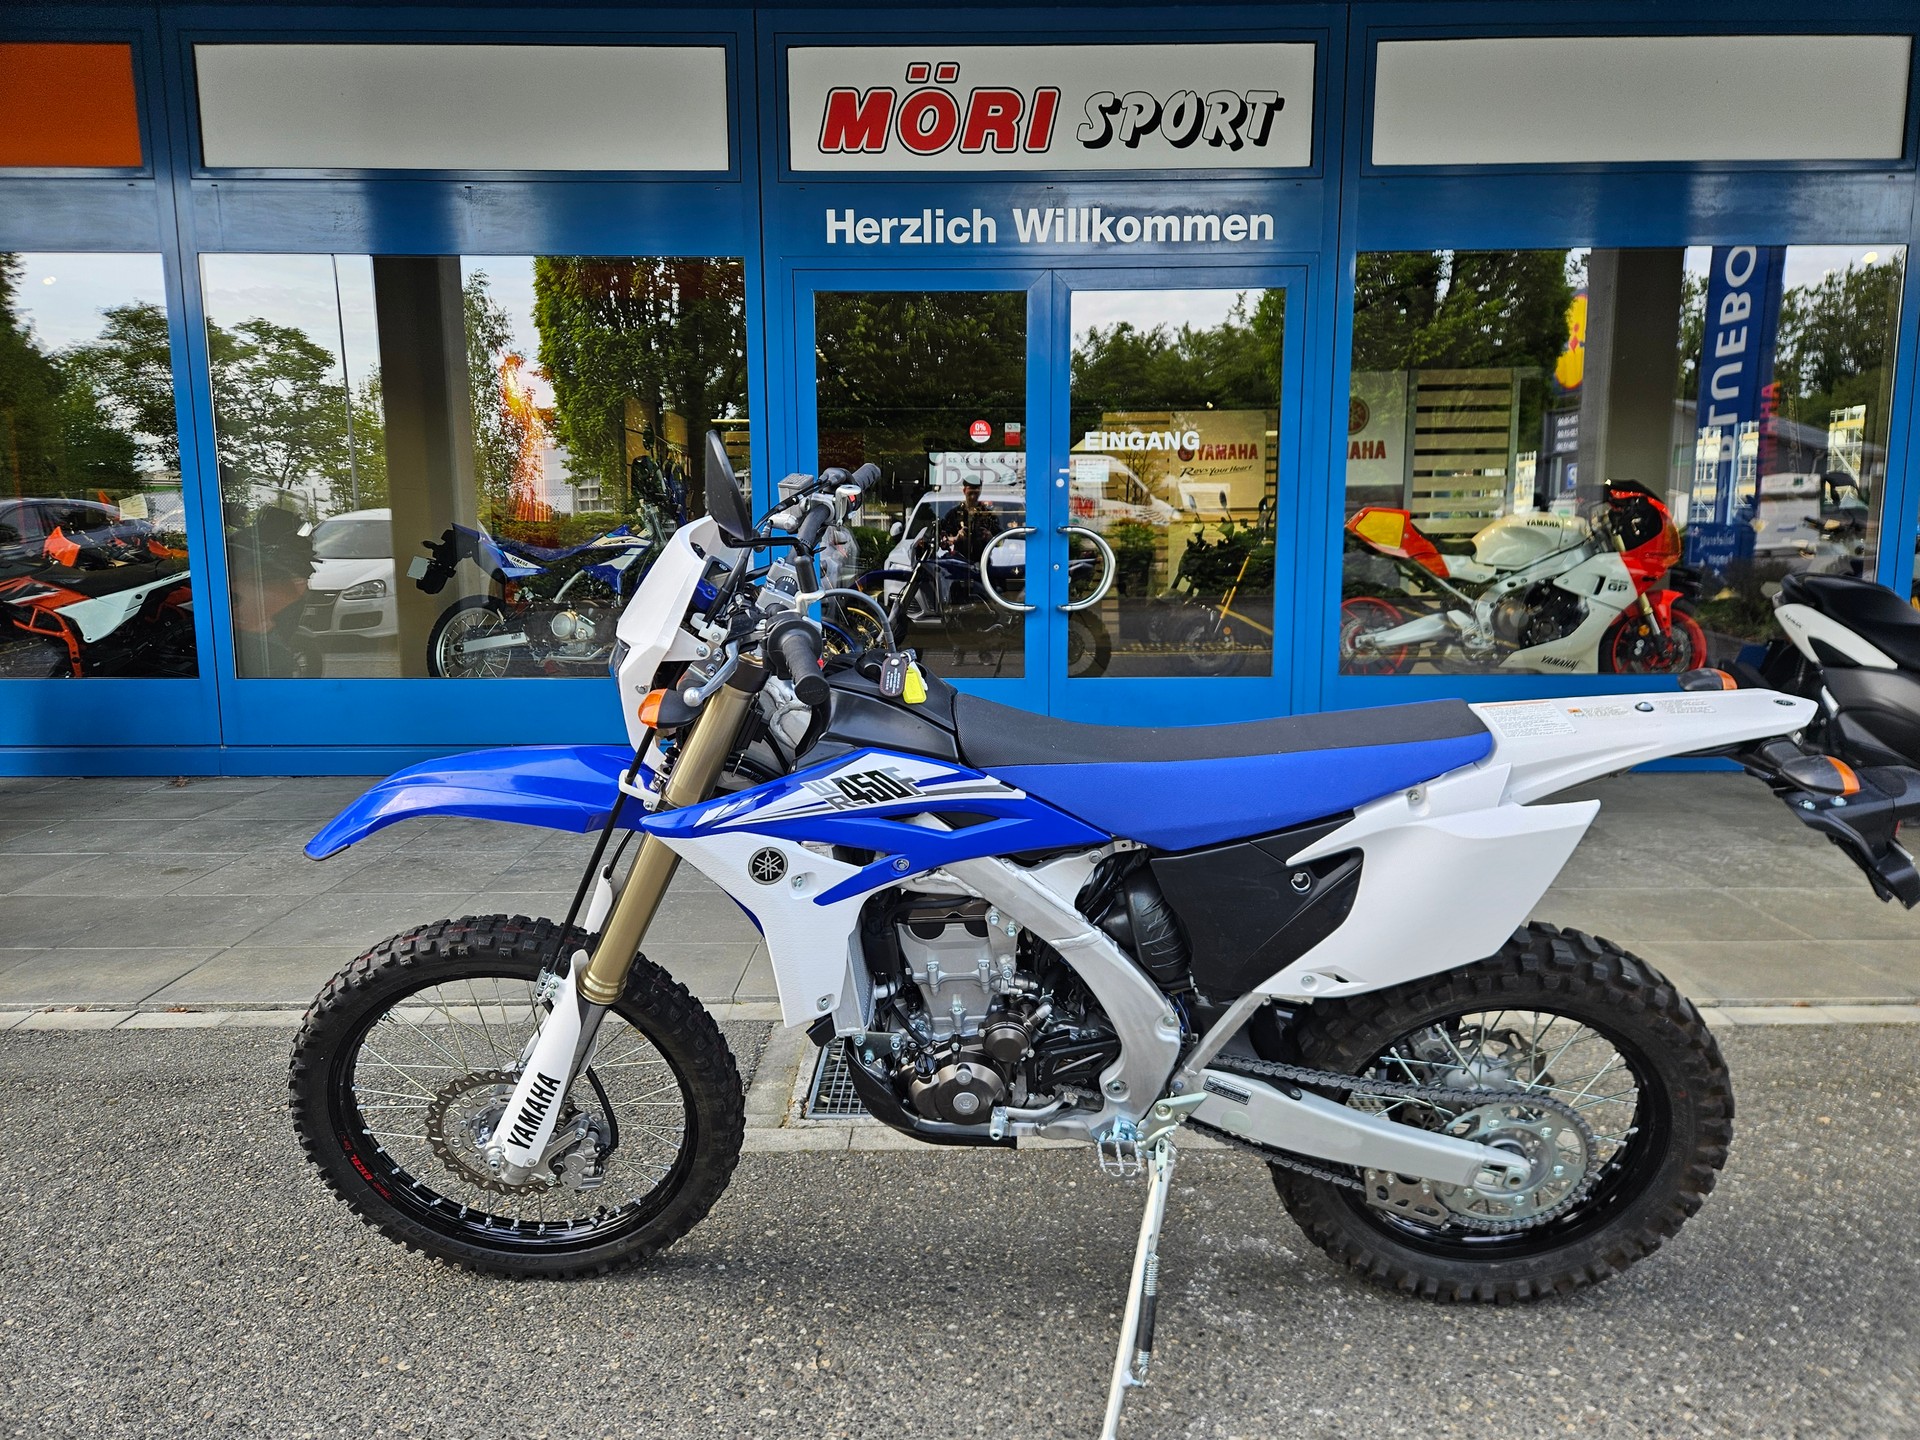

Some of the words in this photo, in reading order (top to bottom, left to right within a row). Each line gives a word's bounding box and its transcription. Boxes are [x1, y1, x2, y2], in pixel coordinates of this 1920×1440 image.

[818, 62, 1061, 156] MÖRI
[1076, 89, 1285, 151] SPORT
[826, 208, 997, 244] Herzlich
[1012, 208, 1275, 244] Willkommen
[1085, 431, 1200, 450] EINGANG
[1196, 443, 1259, 461] YAMAHA
[1347, 440, 1386, 460] AHA
[1208, 466, 1230, 477] Your
[1526, 518, 1560, 529] YAMAHA
[1607, 582, 1629, 592] GP
[1540, 655, 1578, 672] YAMAHA
[507, 1071, 561, 1150] YAMAHA
